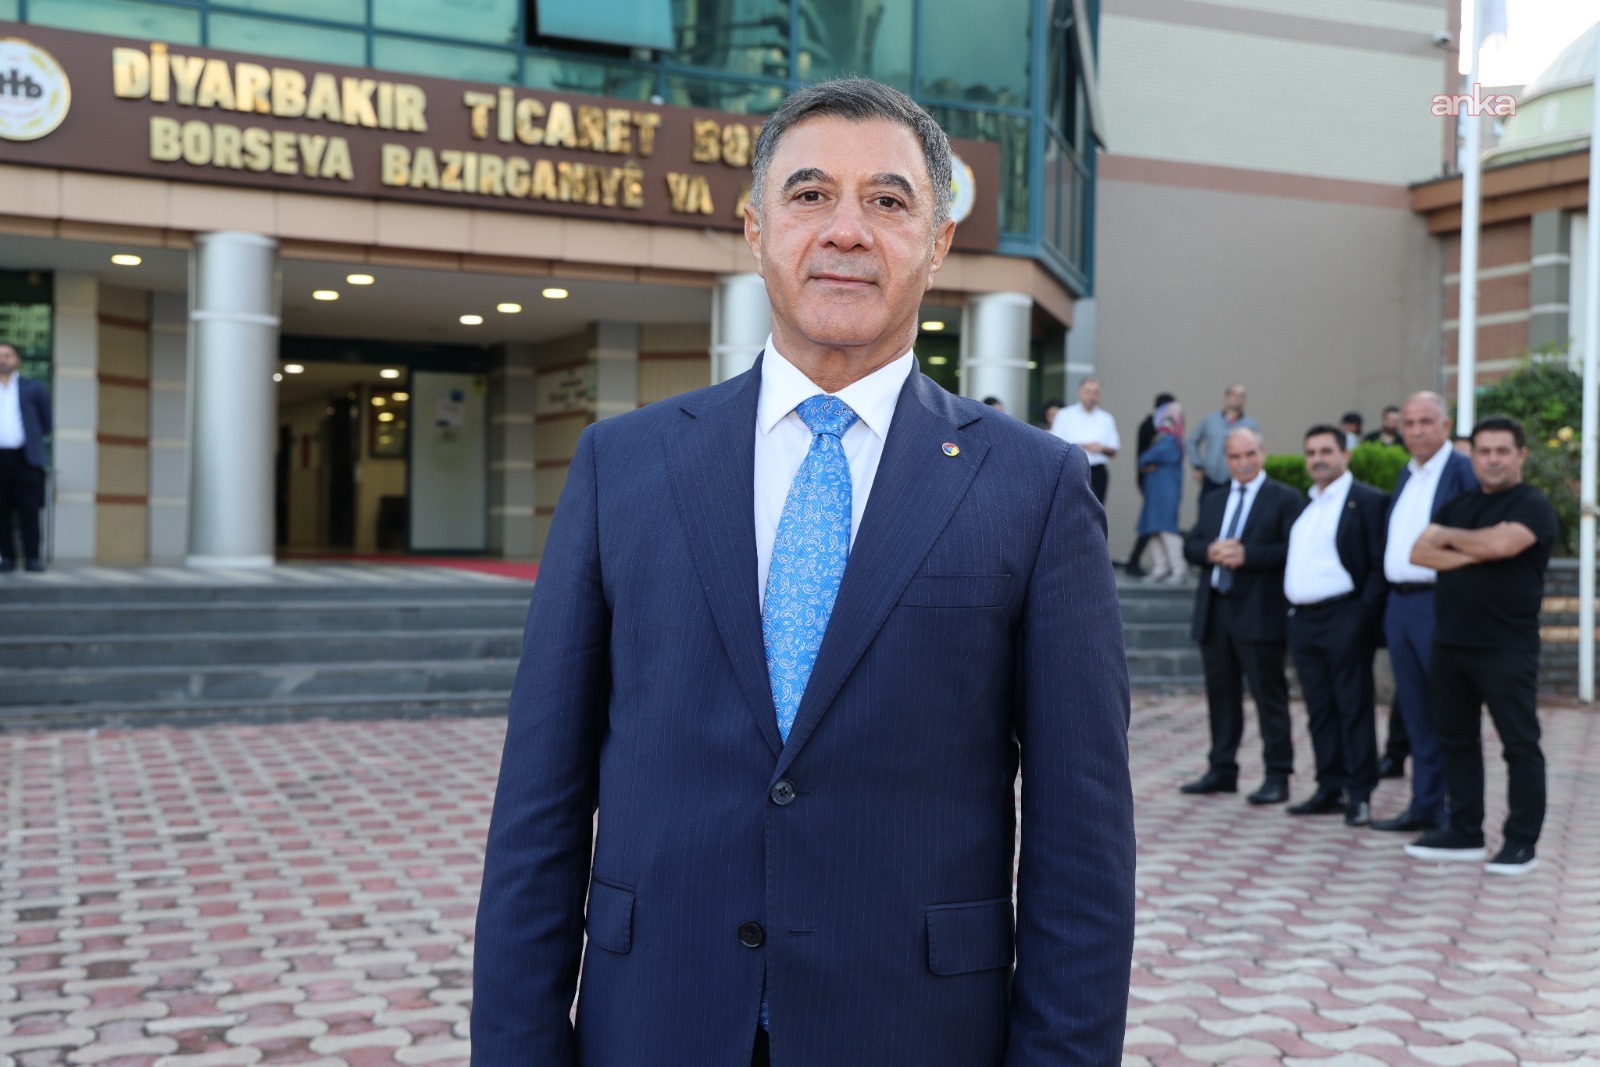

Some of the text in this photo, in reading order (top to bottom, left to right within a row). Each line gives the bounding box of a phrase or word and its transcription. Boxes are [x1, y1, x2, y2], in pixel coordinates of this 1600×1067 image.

[112, 43, 762, 168] DİYARBAKIR TİCARET BO
[149, 116, 354, 181] BORSEYA
